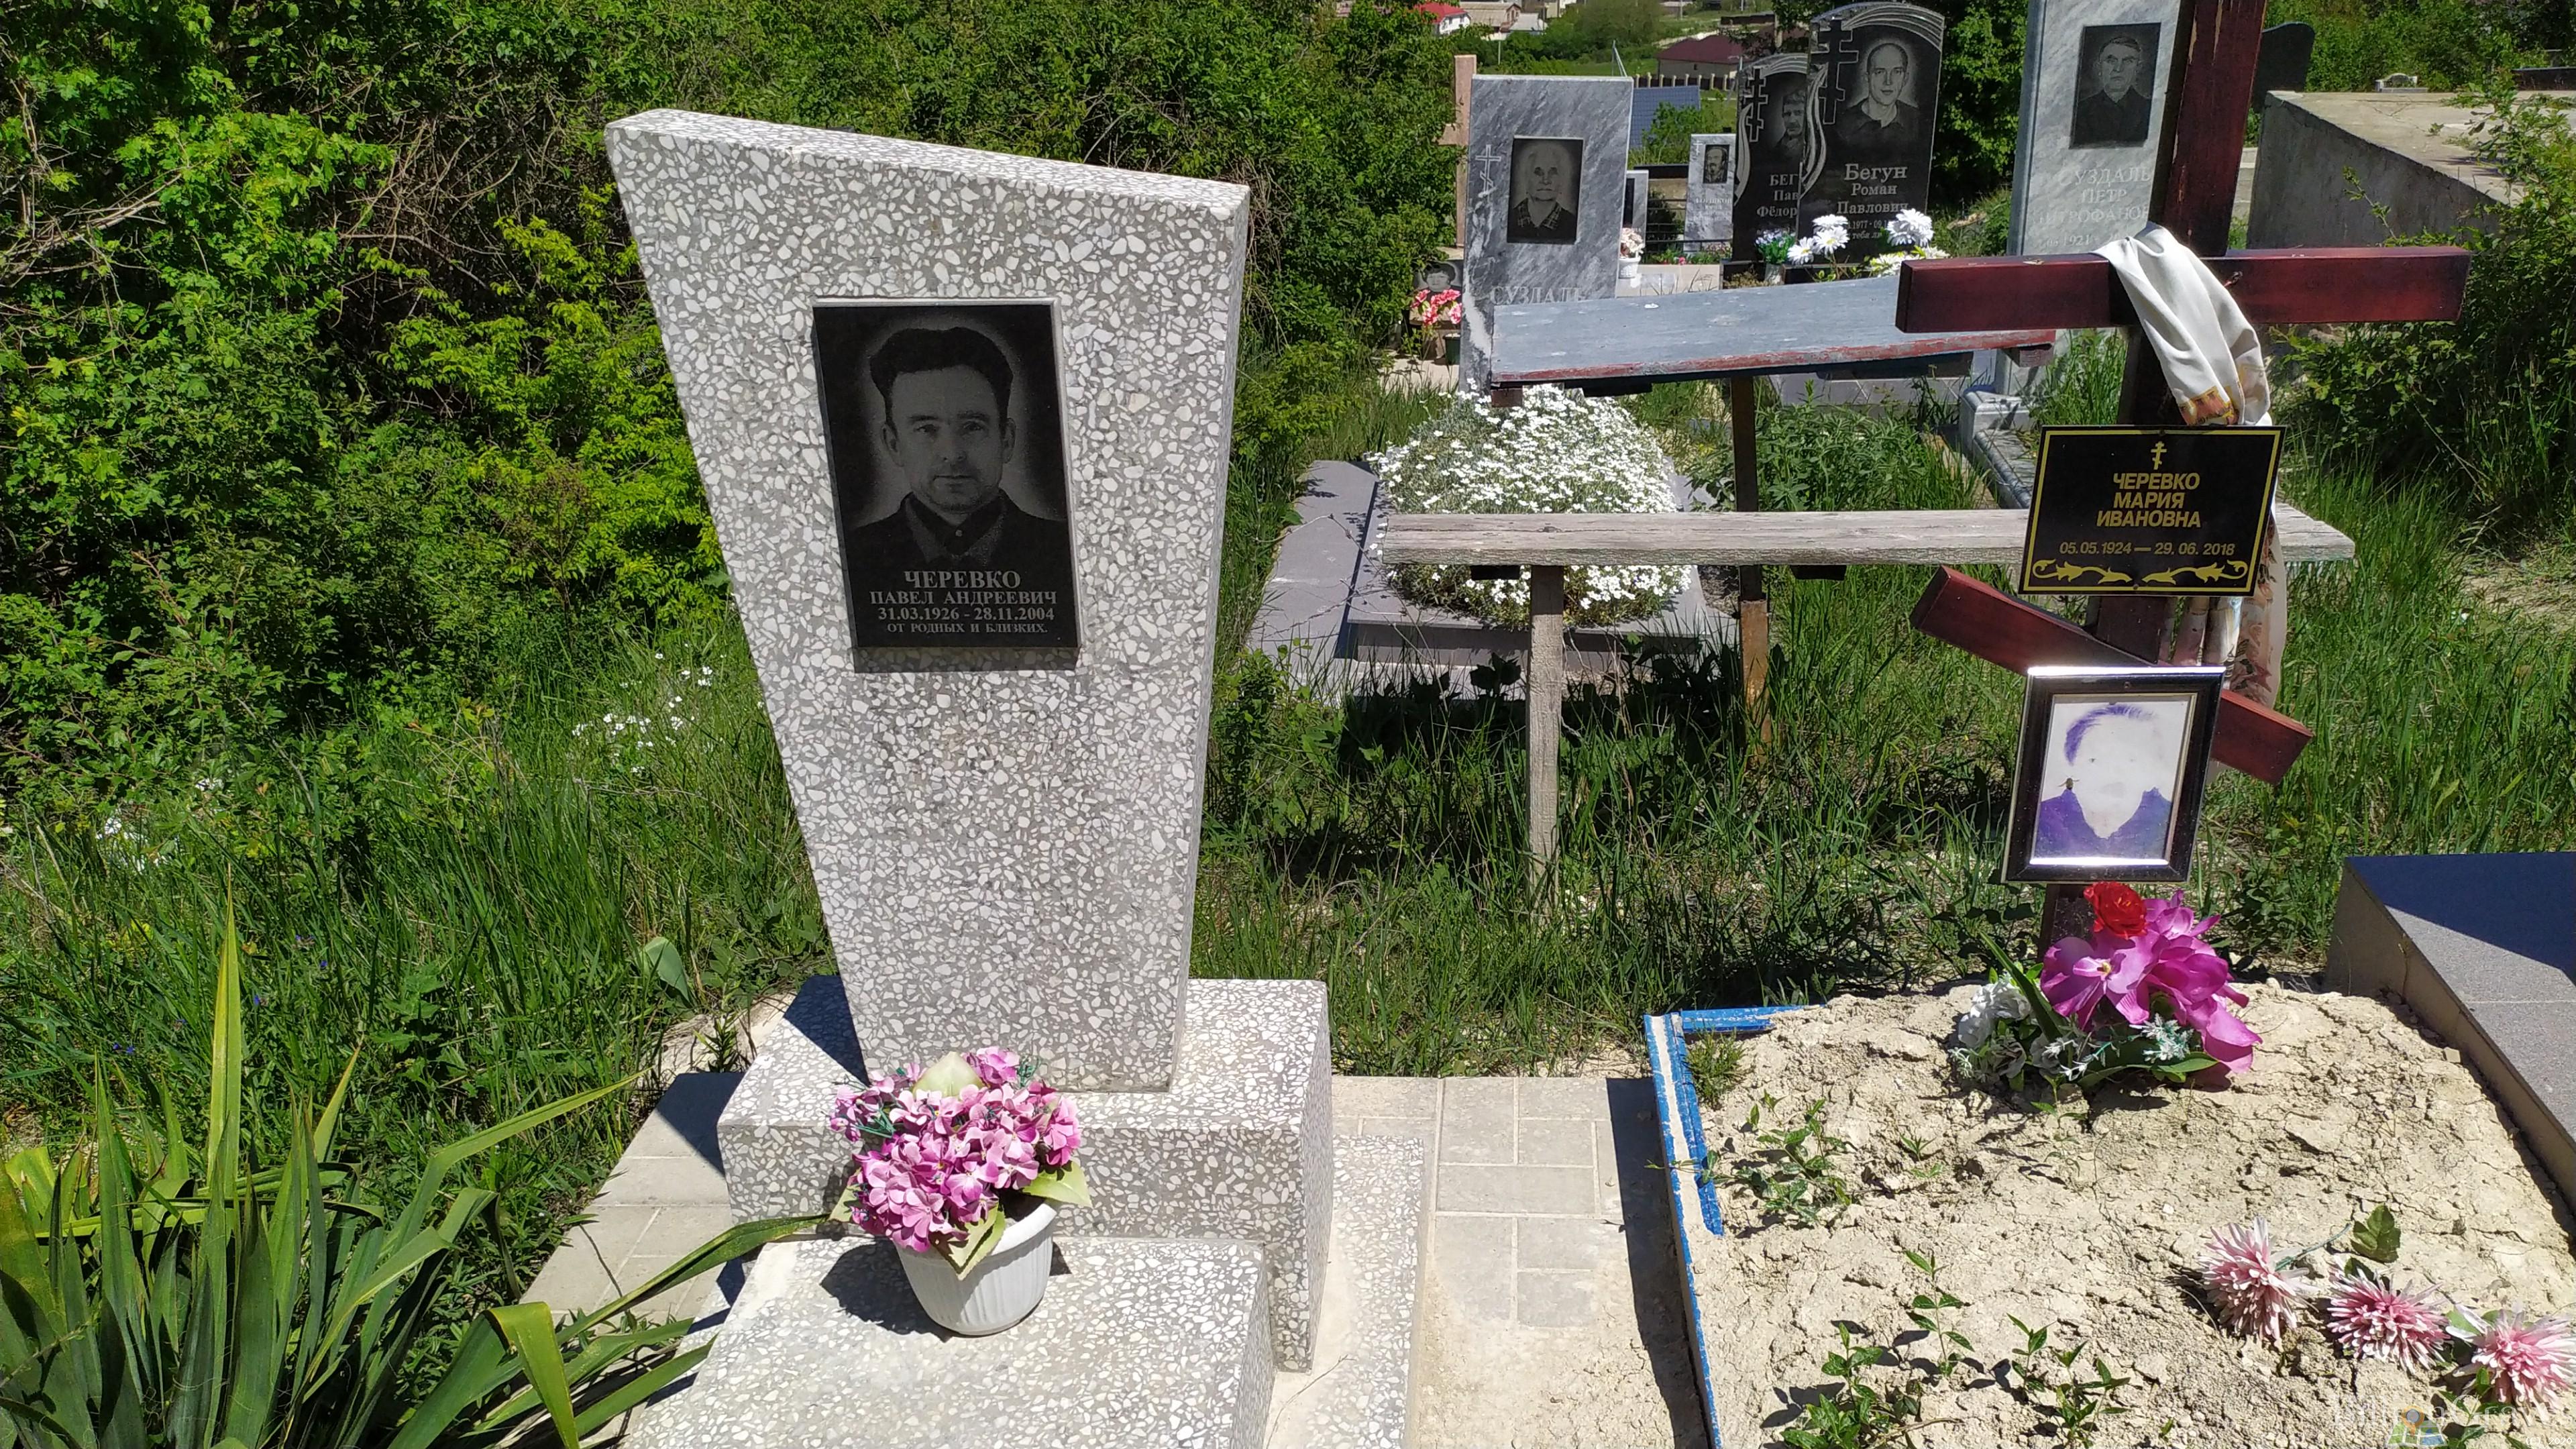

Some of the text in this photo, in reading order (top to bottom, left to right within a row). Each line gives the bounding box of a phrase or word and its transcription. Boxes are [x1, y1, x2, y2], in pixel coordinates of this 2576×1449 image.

[1770, 173, 1799, 186] БЕГ
[1844, 164, 1908, 182] Бегун
[1774, 189, 1799, 201] Пав
[1851, 183, 1898, 196] Роман
[2081, 189, 2128, 203] ПЕТР
[1756, 205, 1798, 218] Фёдор
[2113, 472, 2200, 490] ЧЕРЕВКО
[2113, 492, 2185, 509] МАРИЯ
[2096, 511, 2202, 528] ИВАНОВНА
[904, 570, 1021, 589] ЧЕРЕВКО
[870, 591, 1057, 607] ПАВЕЛ АНДРЕЕВИЧ
[878, 608, 960, 621] 31.03.1926
[974, 607, 1055, 621] 28.11.2004
[888, 623, 1049, 634] ОТ РОДНЫХ И БЛИЗКИХ.
